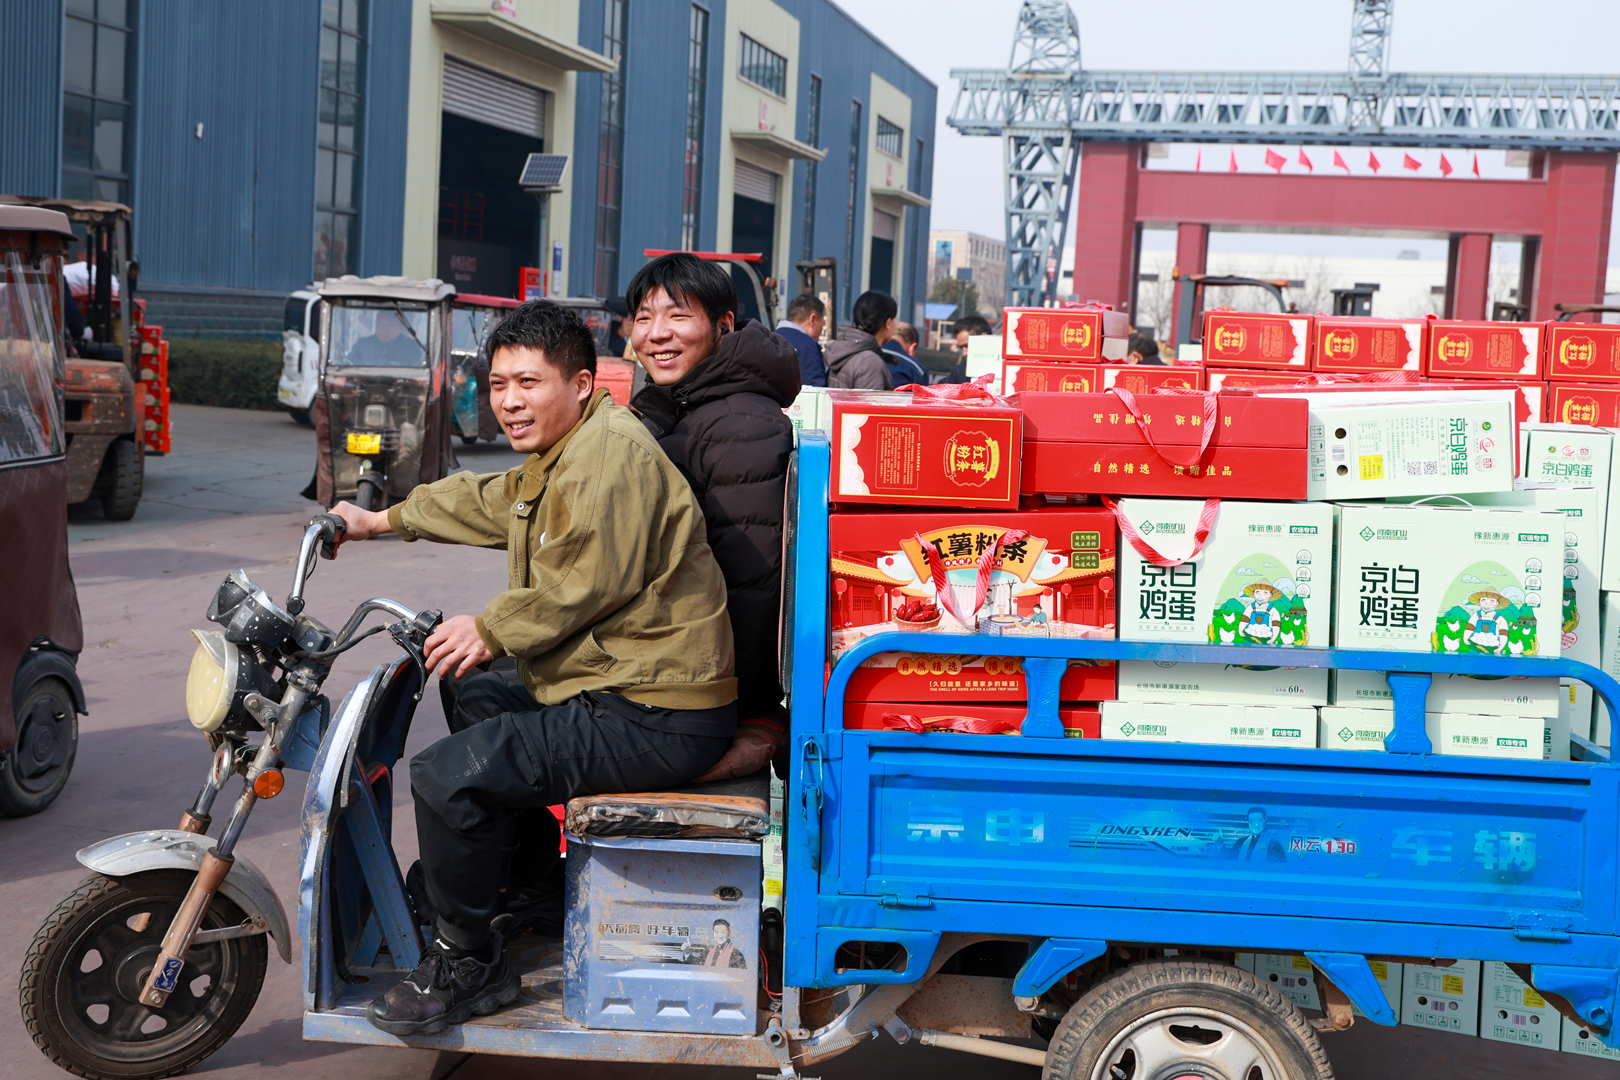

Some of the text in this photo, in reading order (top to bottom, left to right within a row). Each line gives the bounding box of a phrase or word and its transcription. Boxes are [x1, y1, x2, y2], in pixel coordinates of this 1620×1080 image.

[1176, 414, 1232, 426] 自精选
[1450, 418, 1468, 475] 京白鸡蛋
[956, 445, 971, 472] 粉条
[971, 445, 986, 473] 红薯
[1094, 462, 1232, 476] 自然精选 馈赠佳品
[1542, 461, 1593, 478] 京白鸡蛋
[1248, 524, 1282, 533] 豫新惠源
[1474, 531, 1510, 541] 豫新惠源
[1140, 558, 1197, 588] 京白
[1360, 562, 1419, 594] 京白
[1139, 589, 1196, 622] 鸡蛋
[1358, 595, 1419, 629] 鸡蛋
[902, 661, 957, 672] 自然精选
[1452, 735, 1489, 745] 豫新惠源
[1290, 836, 1356, 854] 风云130
